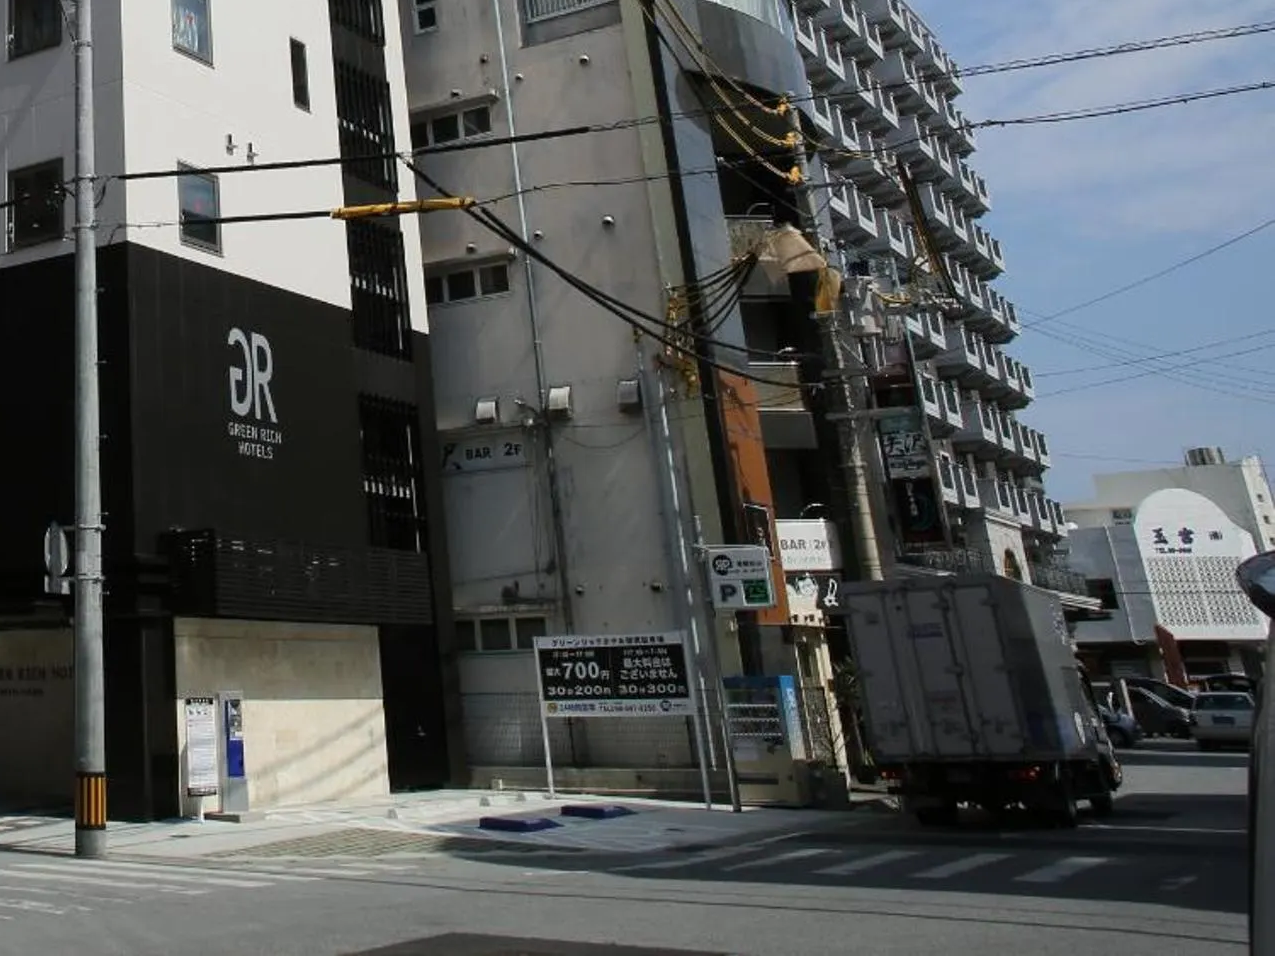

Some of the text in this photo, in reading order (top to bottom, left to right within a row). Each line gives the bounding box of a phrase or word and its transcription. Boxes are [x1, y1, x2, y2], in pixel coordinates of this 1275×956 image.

[228, 422, 282, 444] GREEN RICH
[238, 442, 273, 459] HOTELS
[464, 442, 522, 461] BAR 2F
[780, 538, 807, 551] BAR
[719, 584, 737, 602] P
[17, 666, 46, 680] RICH
[620, 668, 677, 680] ございません
